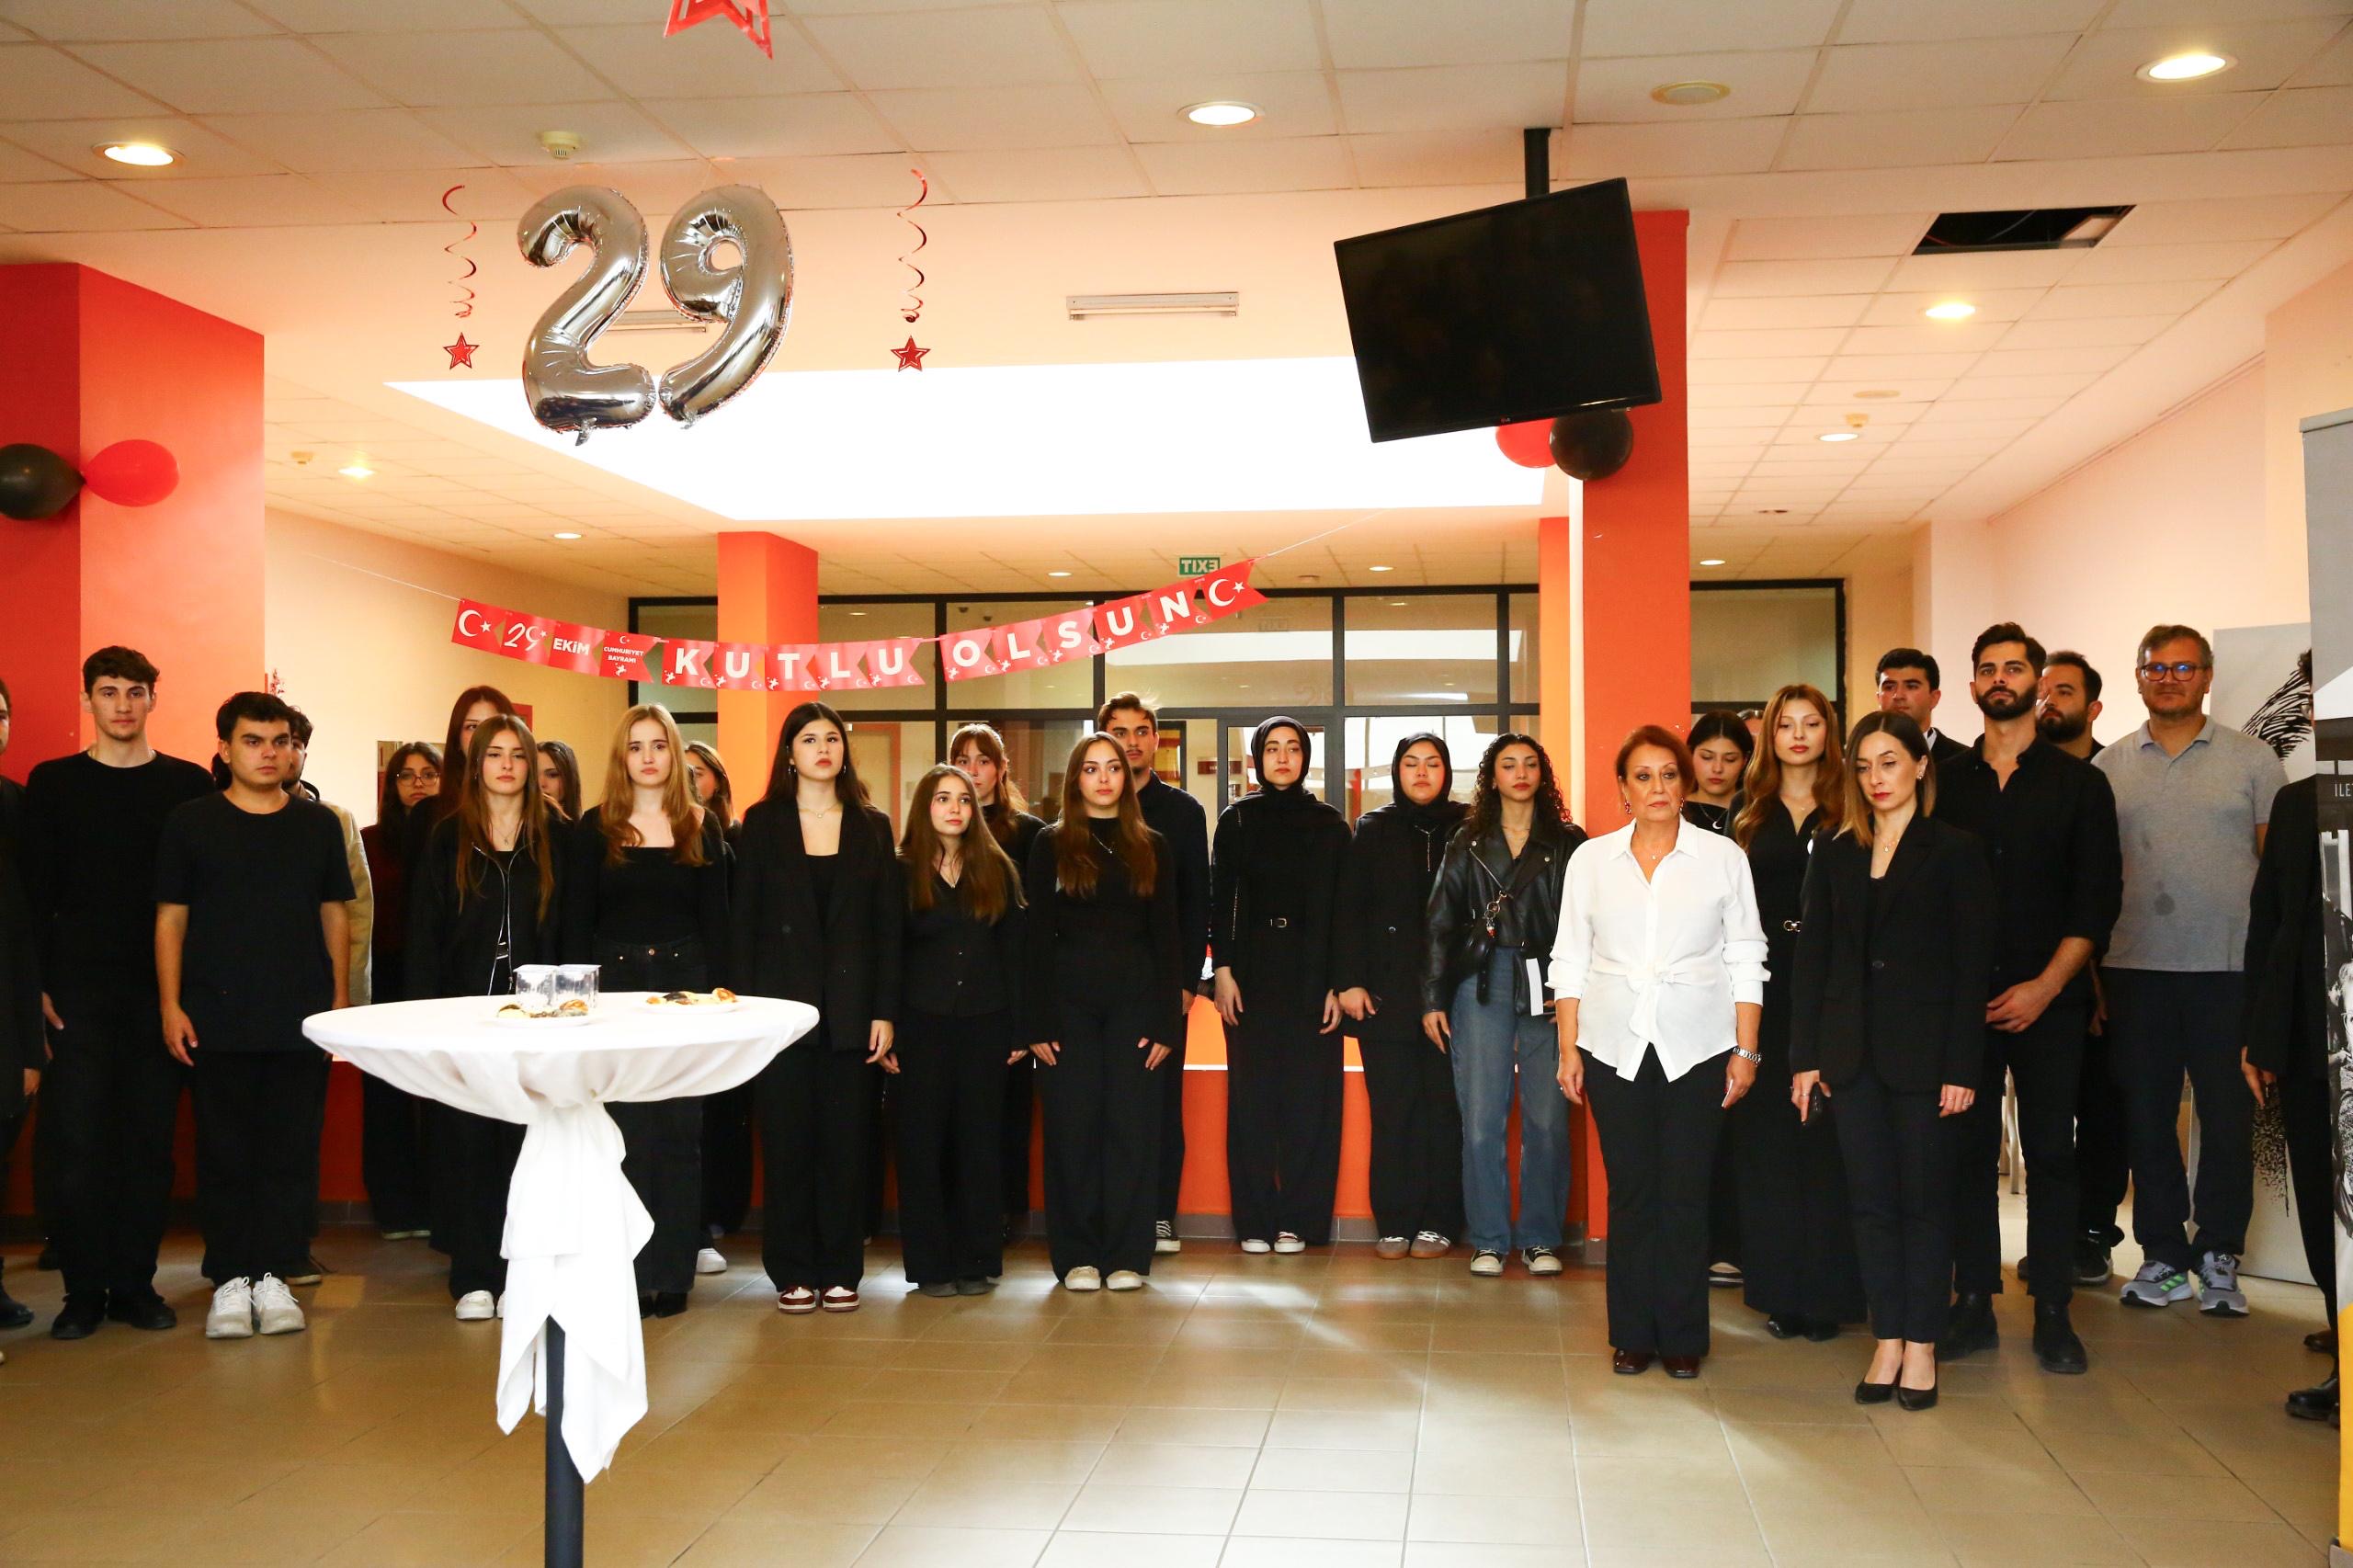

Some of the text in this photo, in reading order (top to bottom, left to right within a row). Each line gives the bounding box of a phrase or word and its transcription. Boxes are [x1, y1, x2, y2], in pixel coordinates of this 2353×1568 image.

[517, 185, 794, 430] 29
[504, 622, 542, 652] 29
[608, 654, 637, 663] BAYRAMI
[2335, 783, 2353, 797] ILE
